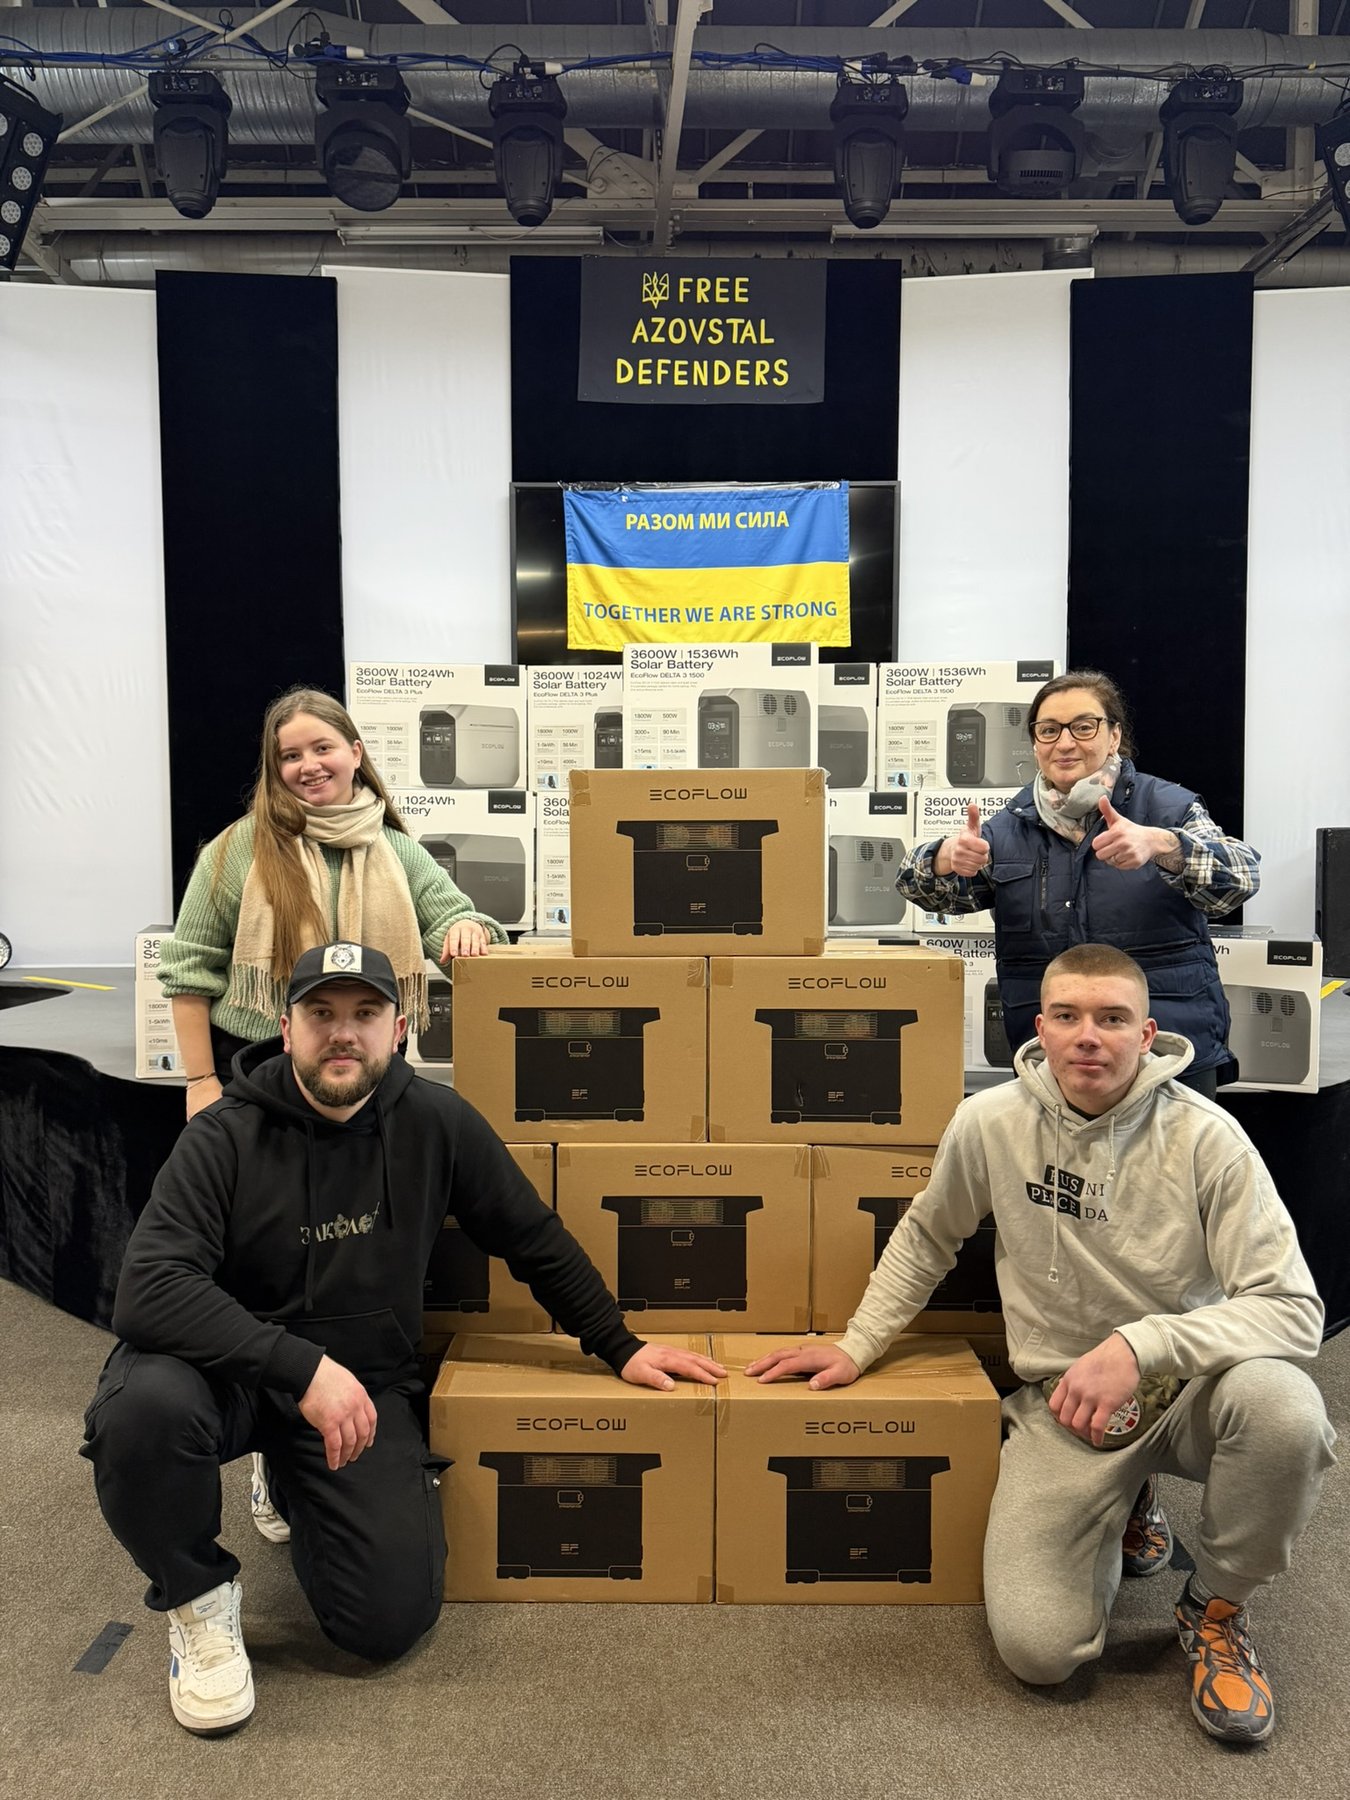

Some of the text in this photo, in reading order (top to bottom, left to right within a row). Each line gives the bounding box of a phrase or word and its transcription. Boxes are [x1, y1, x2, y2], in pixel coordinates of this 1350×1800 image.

[678, 277, 750, 303] FREE
[631, 317, 775, 345] AZOVSTAL
[615, 358, 789, 386] DEFENDERS
[625, 511, 790, 530] РАЗОМ МИ СИЛА
[583, 600, 838, 624] TOGETHER WE ARE STRONG
[630, 649, 739, 659] 3600W 1536Wh
[630, 659, 714, 671] Solar Battery
[356, 667, 455, 678] 3600W 1024Wh
[533, 671, 624, 680] 3600W 1024W
[886, 667, 986, 677] 3600W 1536Wh
[356, 677, 432, 689] Solar Battery
[533, 680, 607, 691] Solar Battery
[886, 677, 963, 688] Solar Battery
[404, 795, 456, 805] 1024Wh
[649, 788, 748, 801] ECOFLOW
[543, 797, 569, 806] 360
[924, 797, 1012, 806] 3600W 1536
[395, 805, 431, 817] attery
[543, 807, 569, 816] Sola
[924, 807, 957, 816] Solar
[926, 938, 964, 949] 600W
[531, 976, 629, 988] ECOFLOW
[788, 977, 887, 989] ECOFLOW
[634, 1164, 733, 1176] ECOFLOW
[1085, 1182, 1105, 1197] NI
[1084, 1206, 1109, 1222] DA
[516, 1418, 627, 1431] ECOFLOW
[805, 1420, 915, 1435] ECOFLOW
